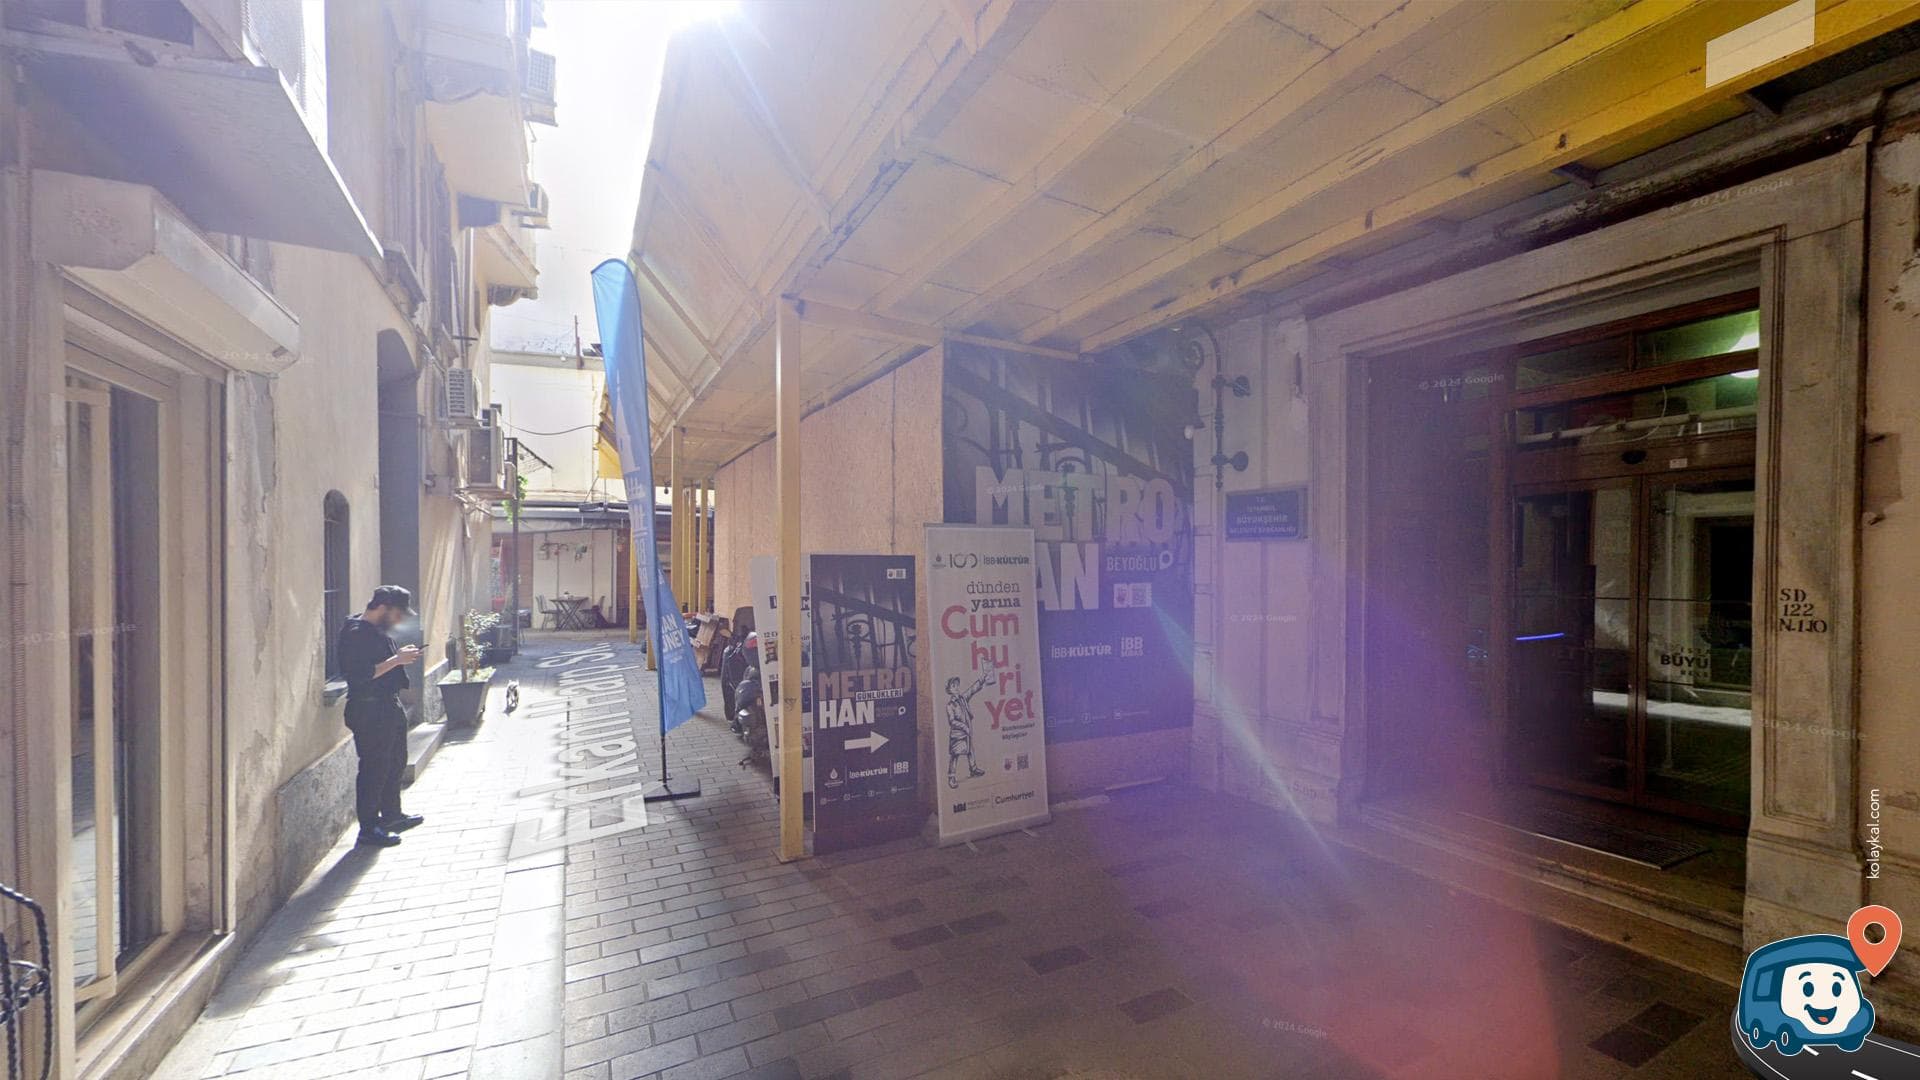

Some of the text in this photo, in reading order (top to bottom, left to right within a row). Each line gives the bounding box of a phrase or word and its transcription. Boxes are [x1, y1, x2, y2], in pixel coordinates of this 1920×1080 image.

[976, 466, 1175, 544] METRO
[966, 581, 1020, 594] dünden
[970, 598, 1021, 613] yarına
[1783, 603, 1814, 617] 122
[941, 604, 1019, 640] Cum
[971, 641, 1009, 671] hu
[817, 666, 912, 700] METRO
[999, 663, 1022, 695] ri
[819, 698, 875, 729] HAN
[984, 690, 1035, 730] yet
